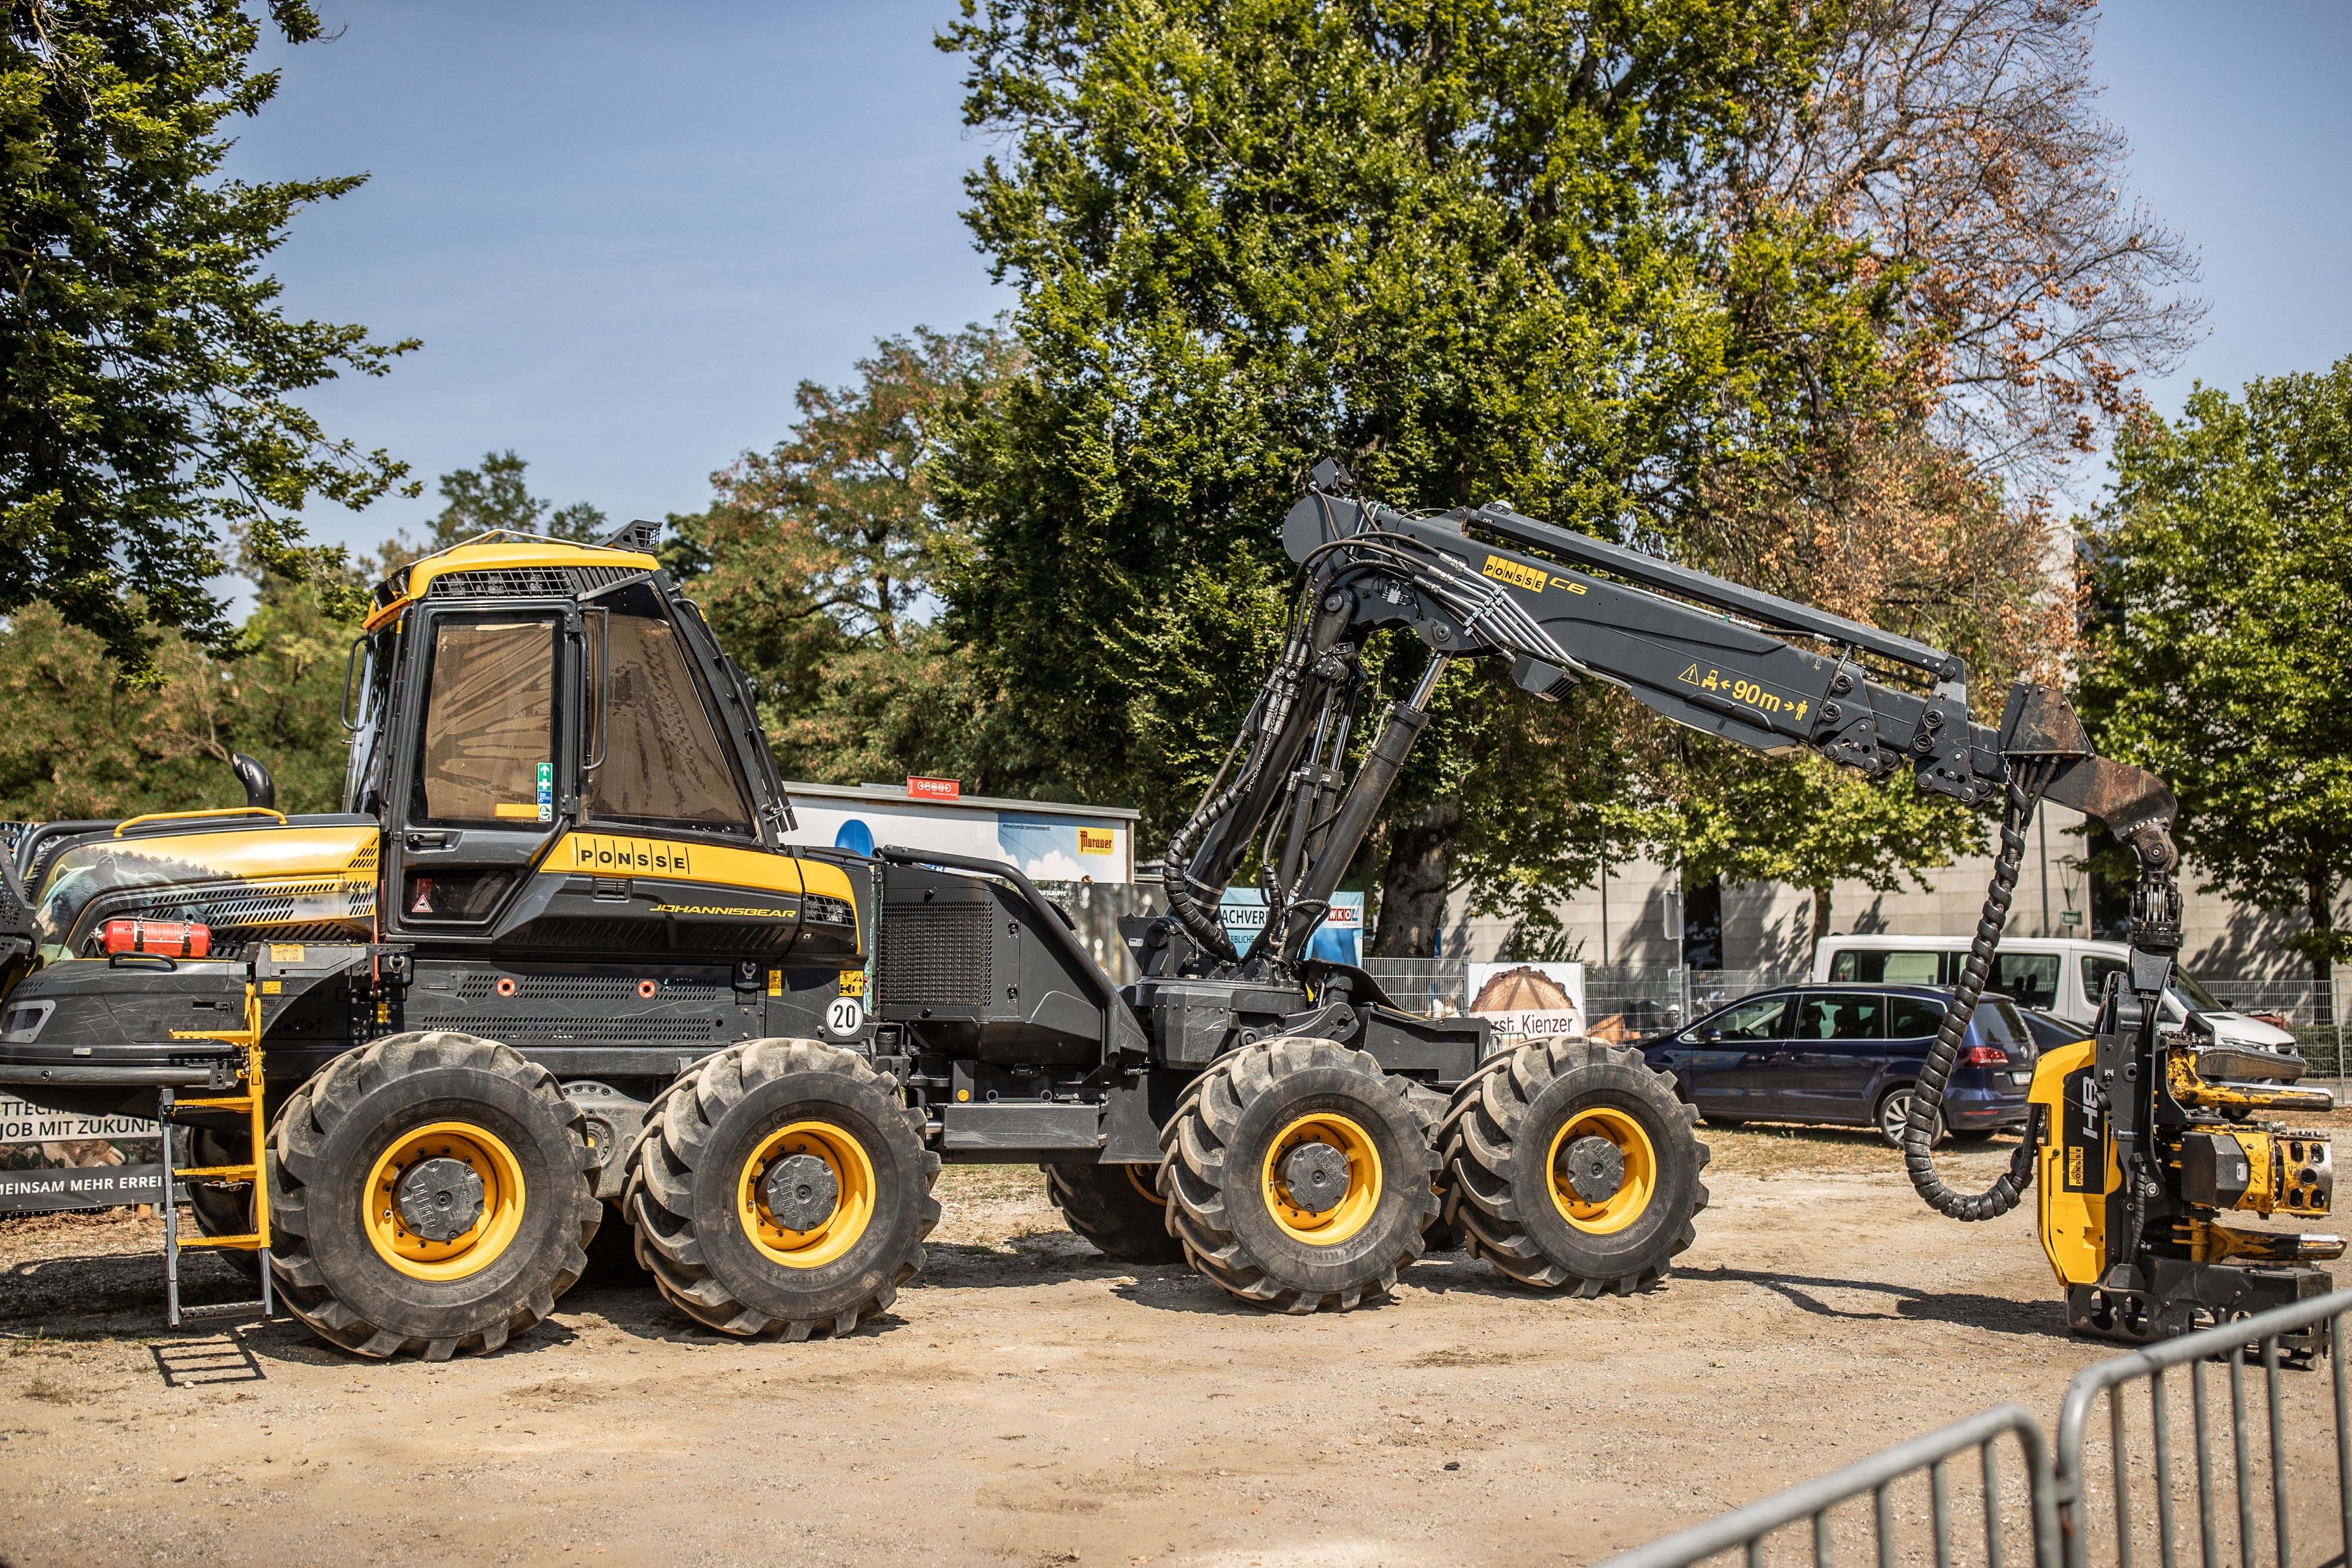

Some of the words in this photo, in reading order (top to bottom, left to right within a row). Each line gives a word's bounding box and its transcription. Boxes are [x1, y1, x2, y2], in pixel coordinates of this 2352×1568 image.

[1485, 564, 1542, 589] PONSSE
[1549, 577, 1588, 596] C6
[1080, 830, 1112, 852] Murauer
[581, 850, 685, 869] PONSSE
[649, 904, 796, 918] JOHANNISBEAR
[833, 1004, 856, 1028] 20
[1522, 1014, 1573, 1034] Kienzer
[39, 1121, 73, 1136] MIT
[70, 1178, 113, 1192] MEHR
